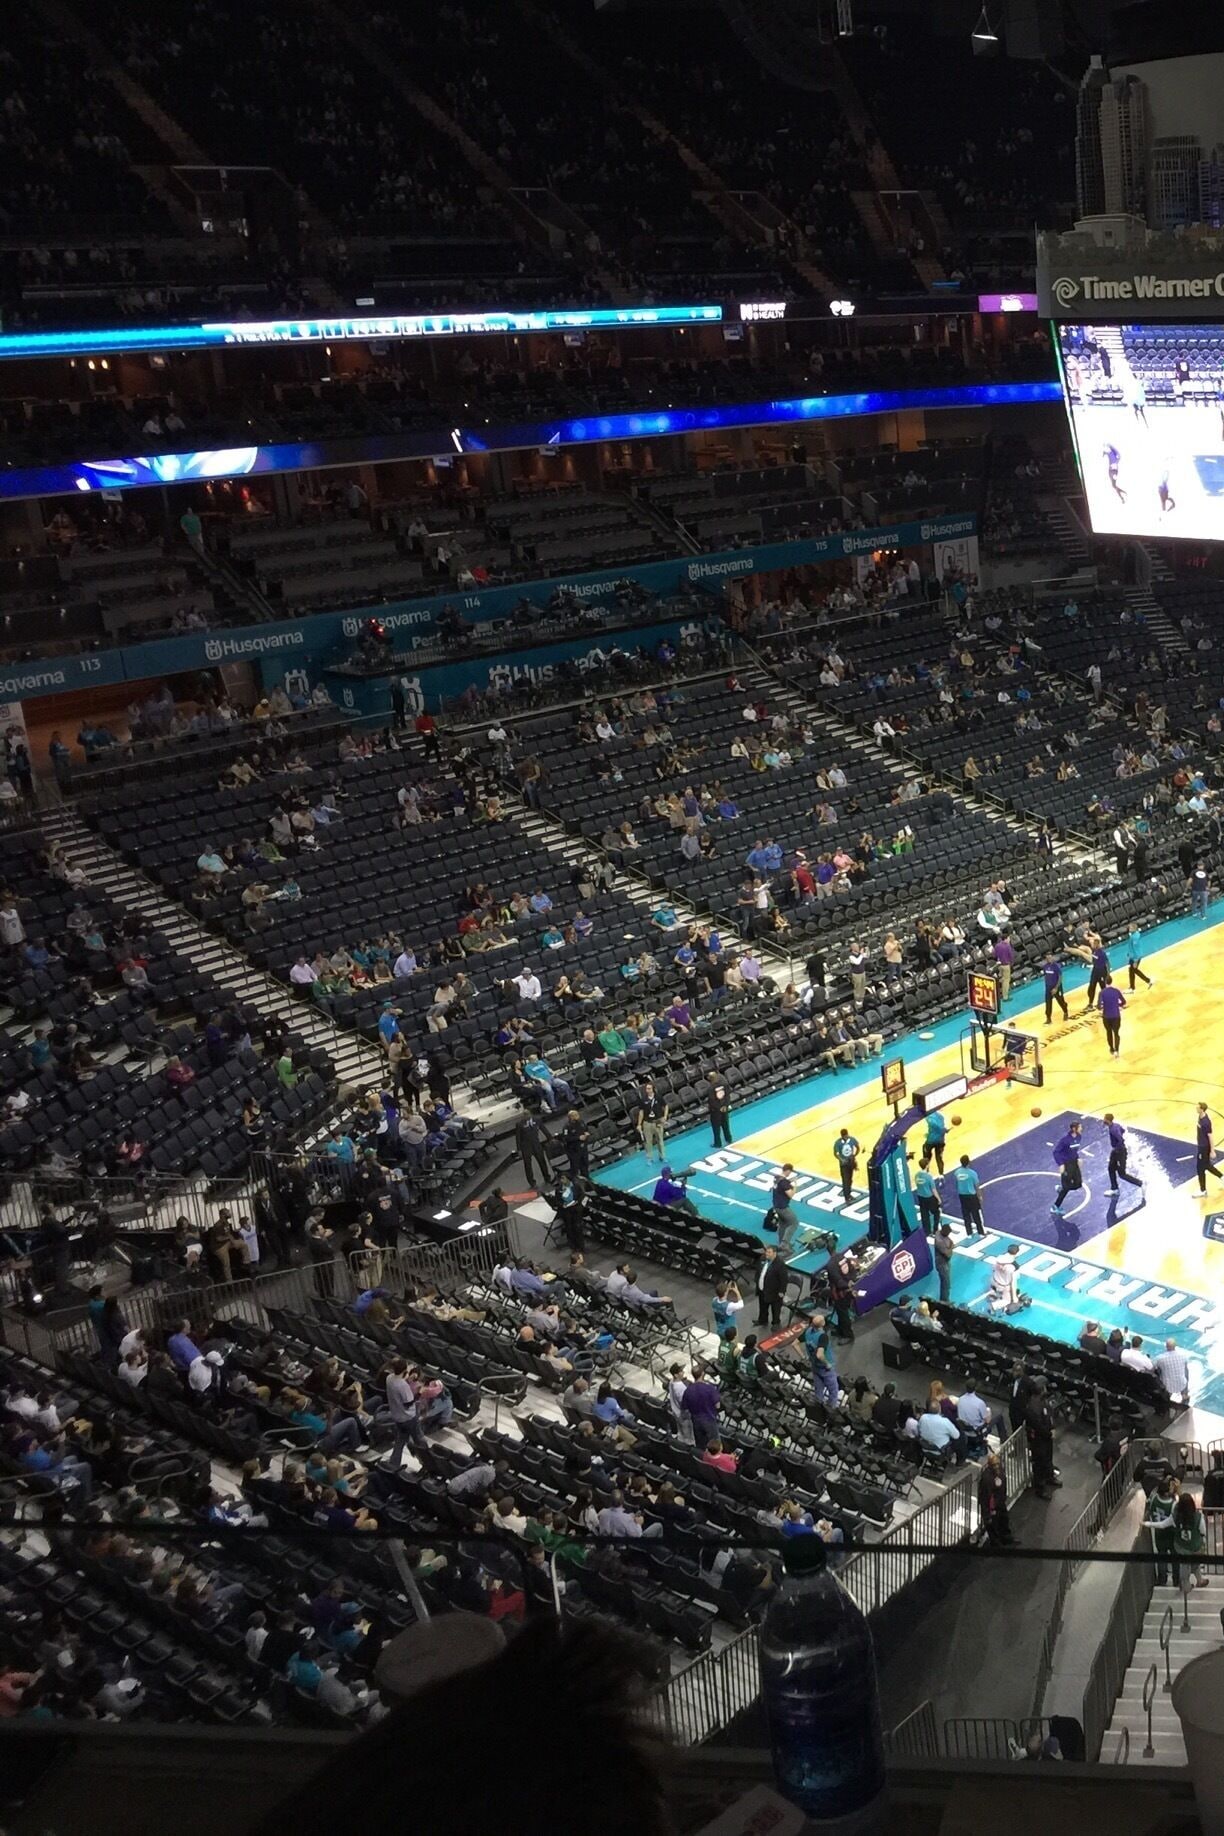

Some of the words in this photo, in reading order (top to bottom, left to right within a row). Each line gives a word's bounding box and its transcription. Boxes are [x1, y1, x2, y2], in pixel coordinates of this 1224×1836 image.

[1080, 276, 1133, 300] Time
[1133, 275, 1213, 299] Warner
[931, 520, 973, 537] Husqvarna
[815, 541, 829, 551] 115
[852, 533, 899, 551] Husqvarna
[699, 556, 754, 577] Husqvarna
[464, 598, 481, 609] 114
[357, 610, 432, 630] sqvarna
[223, 631, 304, 656] Husqvarna
[80, 658, 102, 673] 113
[974, 986, 993, 1007] 24
[895, 1258, 913, 1274] CPI
